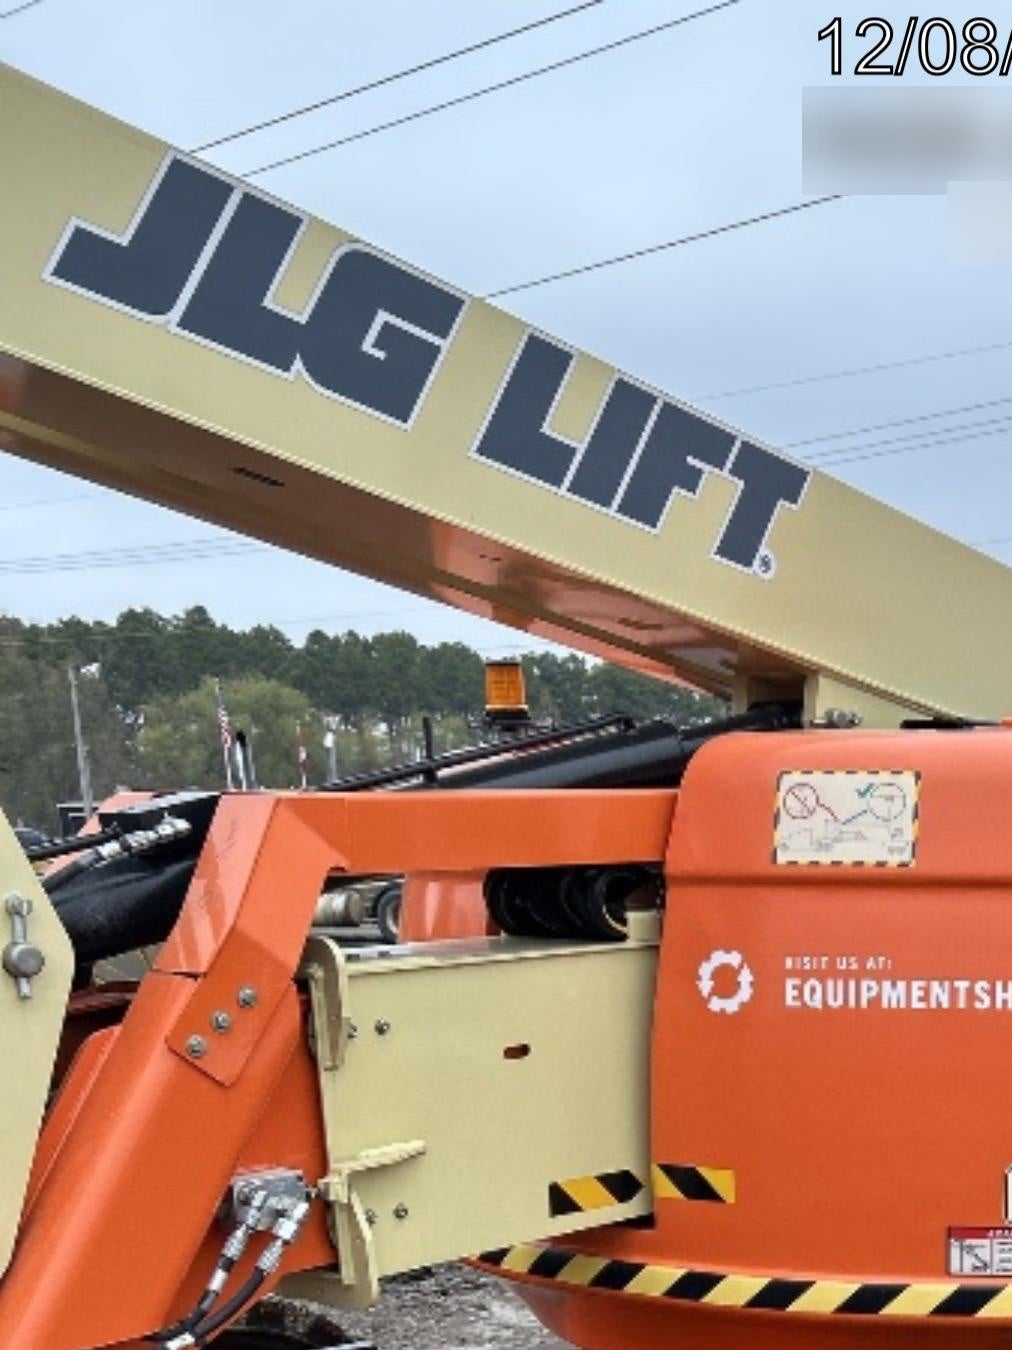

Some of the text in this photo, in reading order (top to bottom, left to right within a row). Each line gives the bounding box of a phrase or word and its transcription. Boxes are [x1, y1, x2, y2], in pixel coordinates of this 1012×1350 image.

[41, 148, 813, 576] JLG LIFT
[836, 955, 860, 971] US
